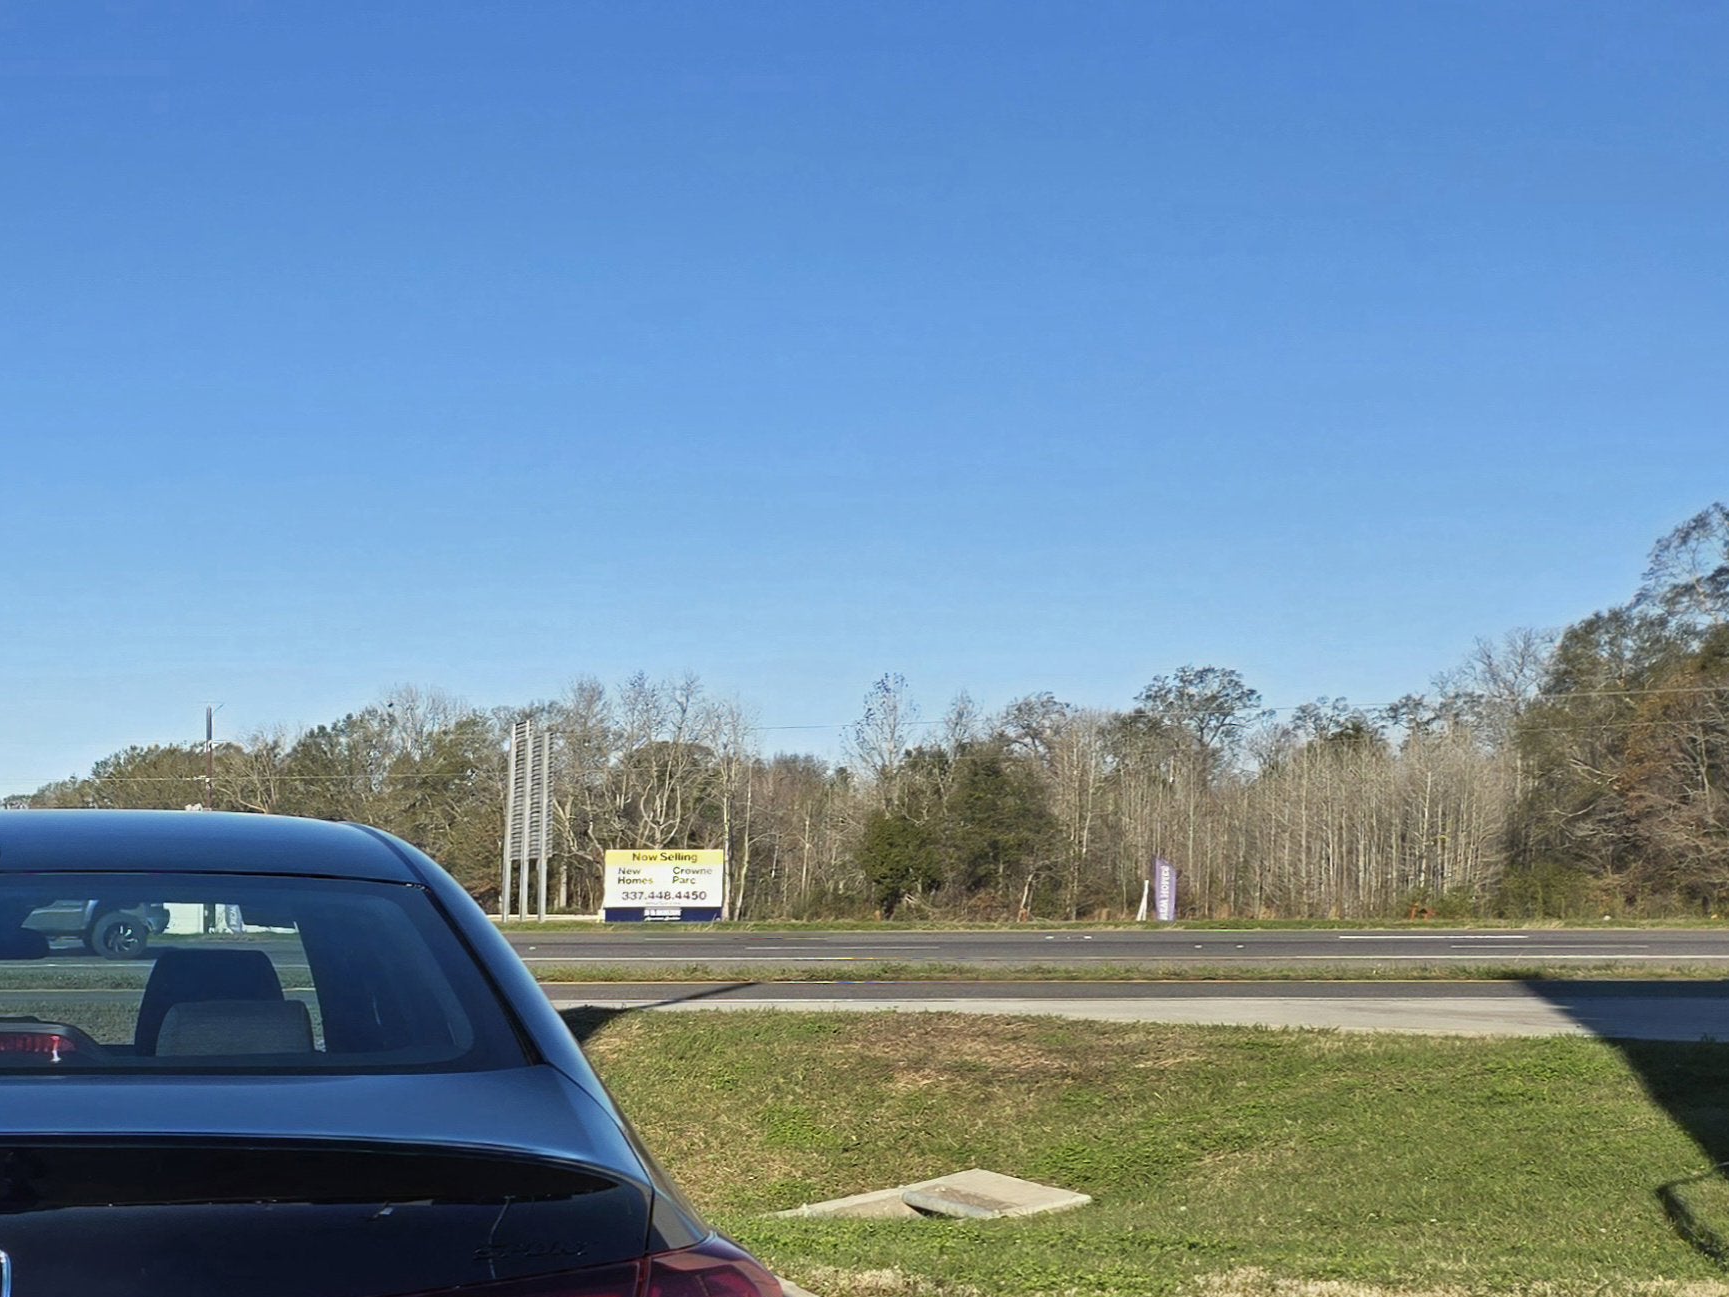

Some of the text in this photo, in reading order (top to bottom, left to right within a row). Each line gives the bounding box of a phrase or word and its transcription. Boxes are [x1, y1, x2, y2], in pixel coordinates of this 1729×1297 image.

[632, 852, 698, 863] Now Selling
[617, 867, 642, 875] New
[672, 866, 713, 875] Crowne
[617, 876, 654, 885] Homes
[672, 875, 696, 885] Parc
[621, 890, 707, 901] 337.448.4450
